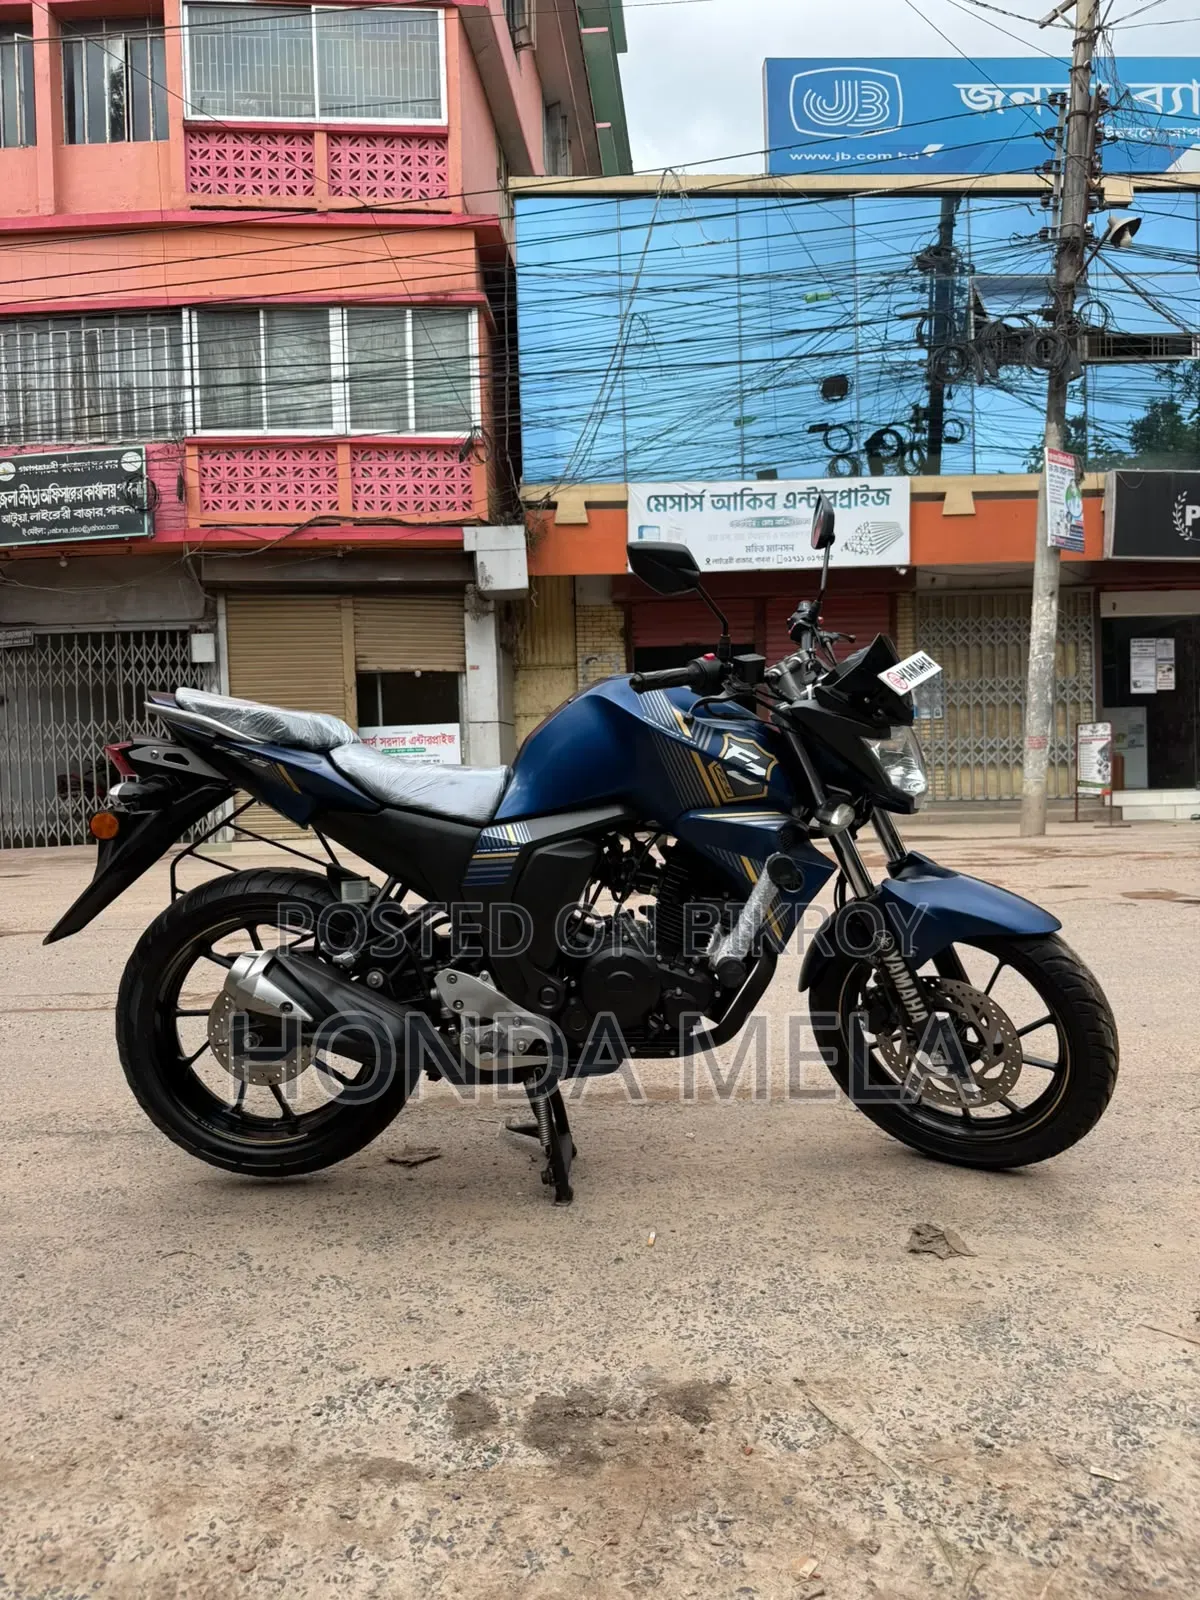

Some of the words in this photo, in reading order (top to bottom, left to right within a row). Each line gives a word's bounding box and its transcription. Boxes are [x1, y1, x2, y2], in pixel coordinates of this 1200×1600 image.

[789, 152, 919, 162] www.jb.combd
[0, 489, 18, 509] জলা
[646, 489, 705, 513] মেসার্স
[710, 487, 777, 512] আকিব
[896, 655, 936, 682] YAMAHA
[882, 949, 929, 1023] YAMAHA
